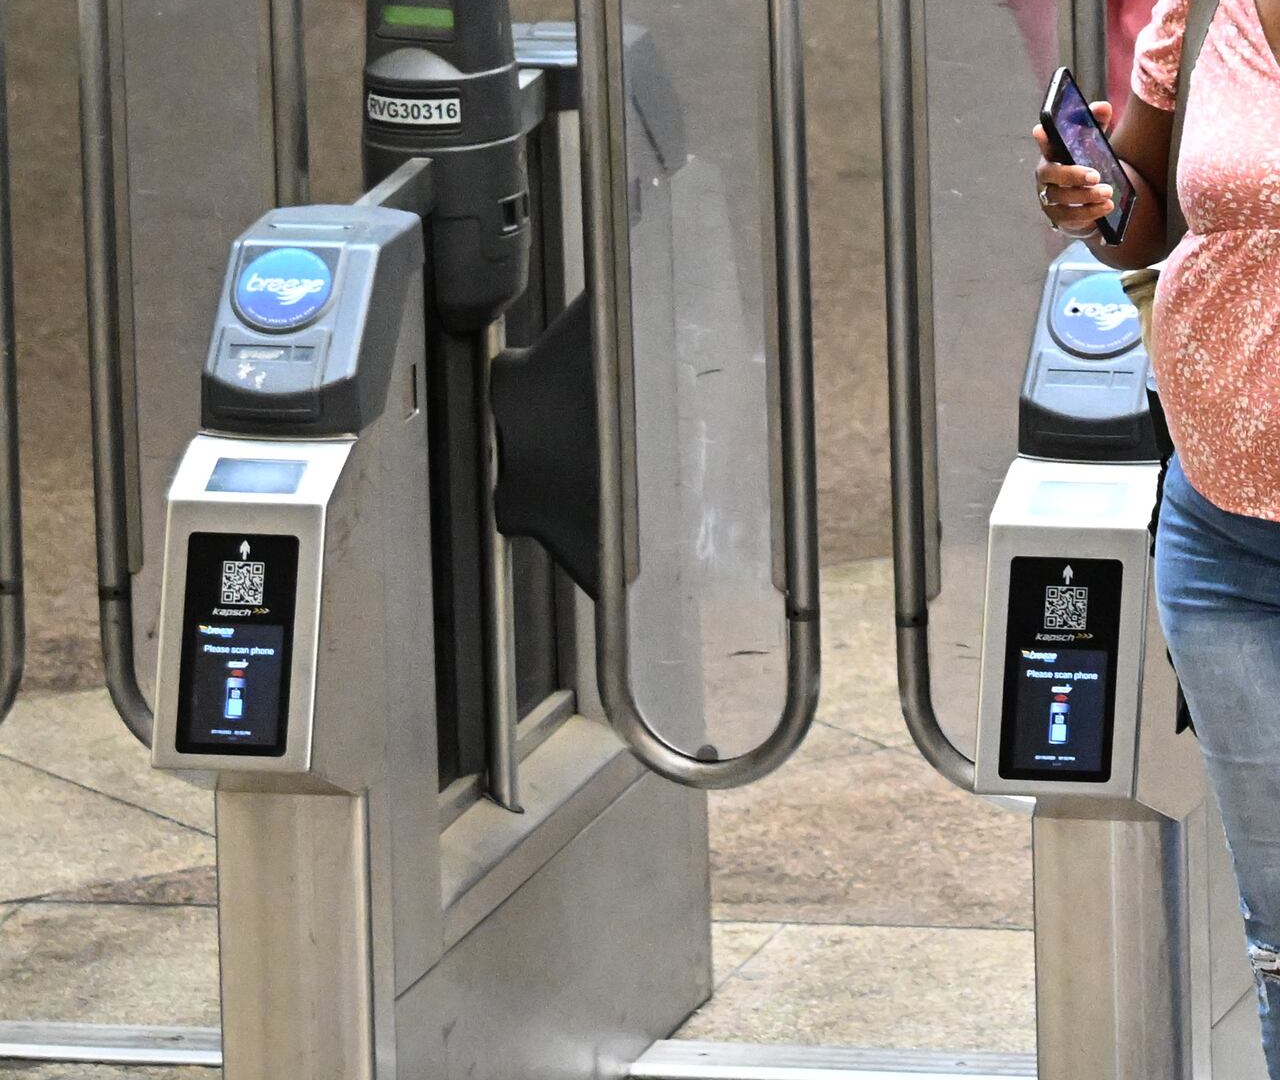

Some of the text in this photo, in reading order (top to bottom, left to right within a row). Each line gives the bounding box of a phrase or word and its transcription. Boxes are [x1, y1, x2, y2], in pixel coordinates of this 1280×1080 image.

[369, 97, 458, 119] RVG30316
[212, 607, 251, 616] kapsch
[1035, 633, 1075, 641] kapsch
[203, 645, 230, 653] Please
[250, 646, 274, 656] phone
[1026, 670, 1053, 678] Please
[1073, 672, 1098, 680] phone
